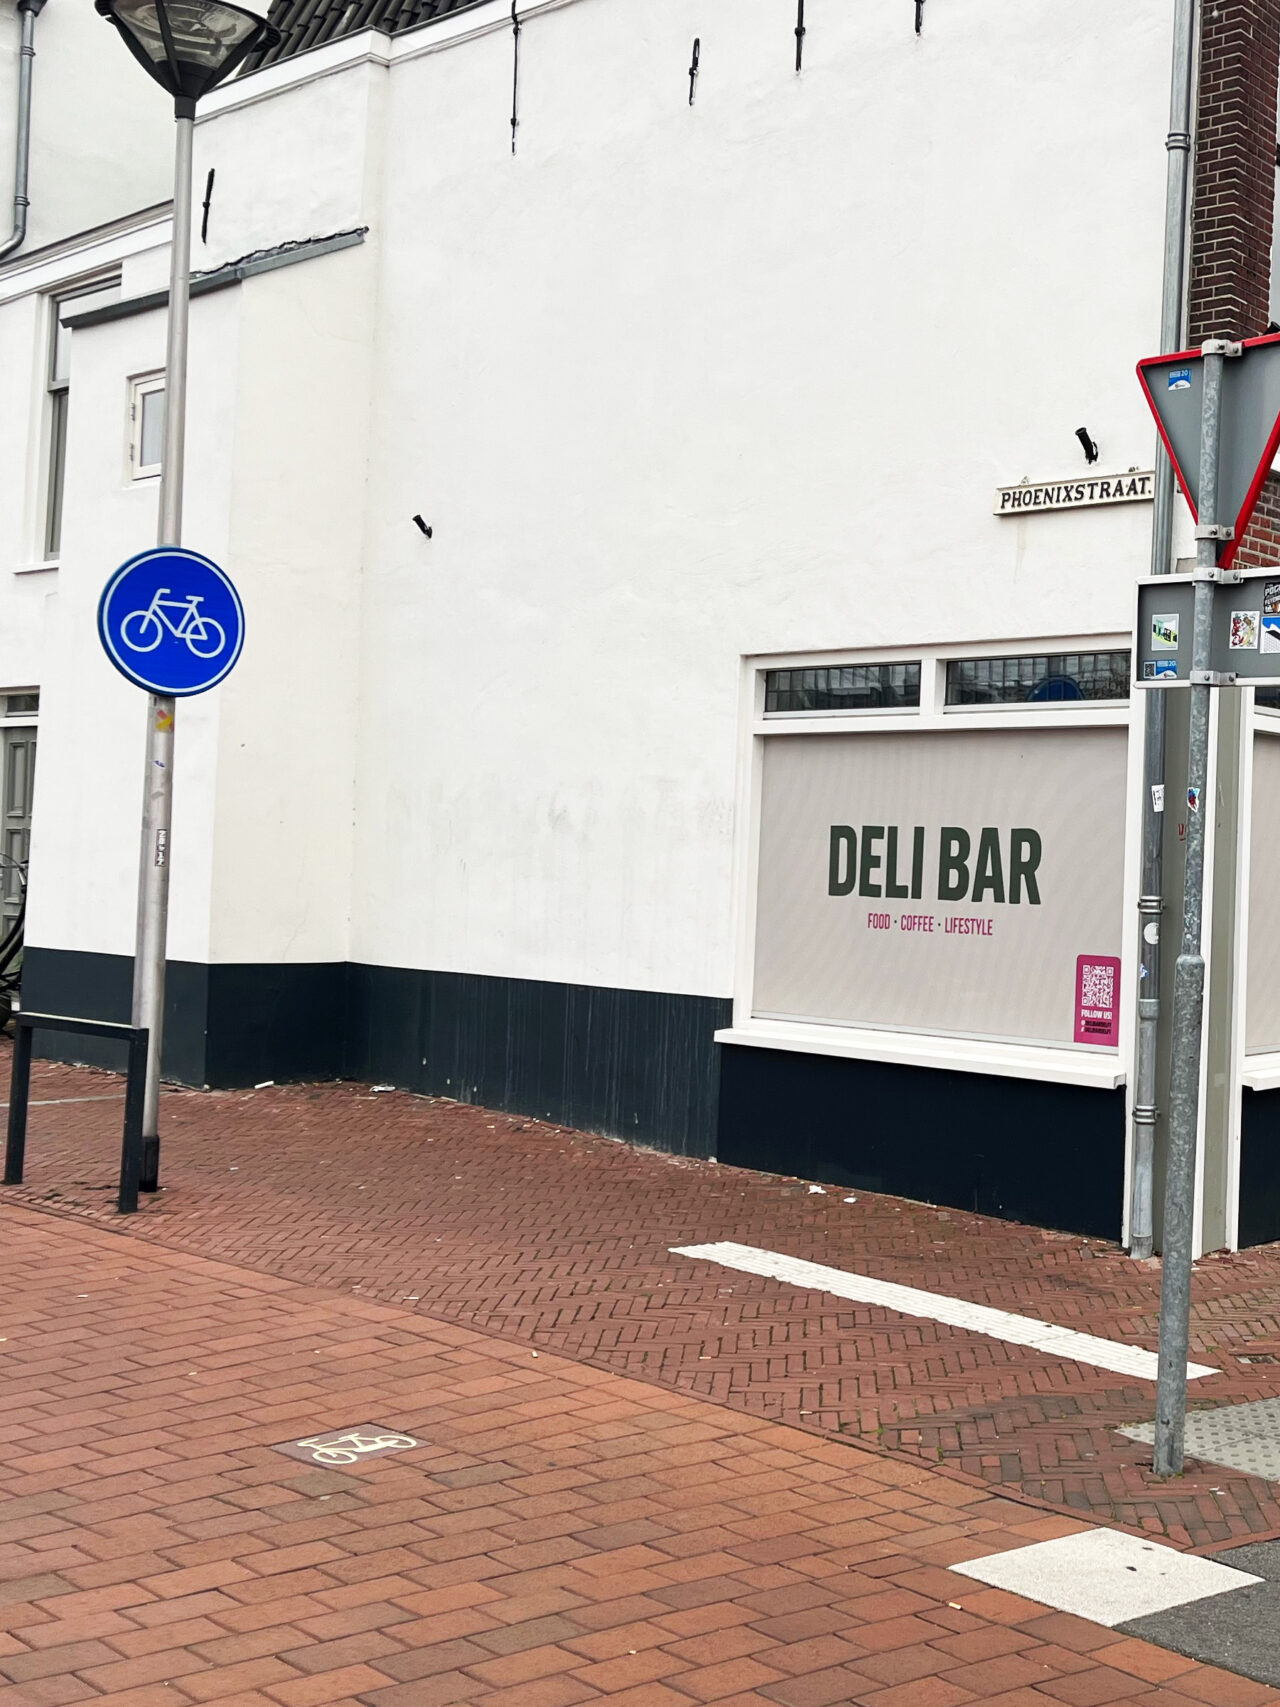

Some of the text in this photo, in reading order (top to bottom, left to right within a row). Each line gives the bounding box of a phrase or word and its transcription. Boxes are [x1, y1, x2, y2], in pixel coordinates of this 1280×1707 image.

[828, 825, 1042, 905] DELI BAR
[867, 912, 994, 936] FOOD COFFEE LIFESTYLE
[1080, 1009, 1103, 1018] FOLLOW
